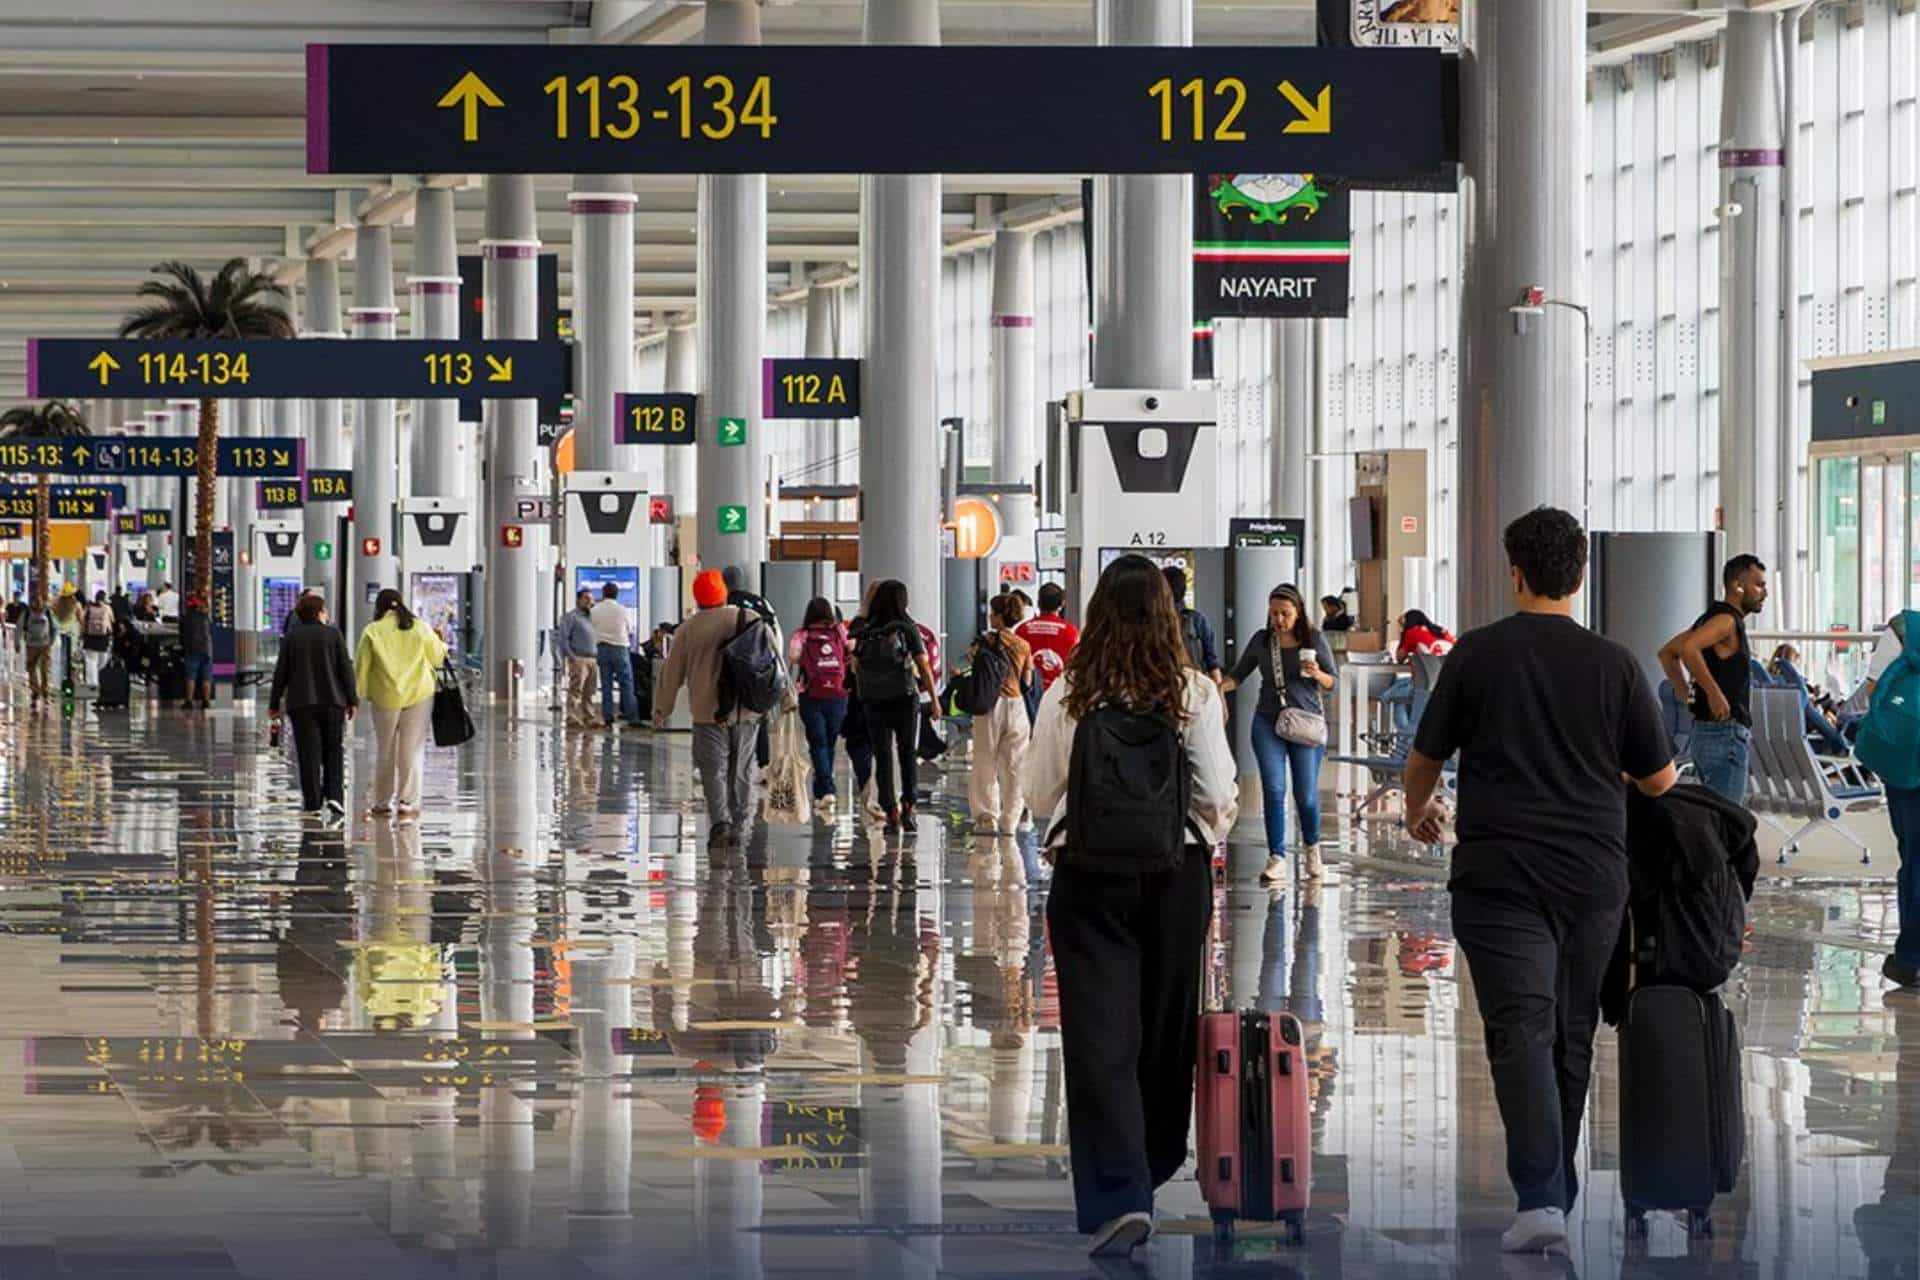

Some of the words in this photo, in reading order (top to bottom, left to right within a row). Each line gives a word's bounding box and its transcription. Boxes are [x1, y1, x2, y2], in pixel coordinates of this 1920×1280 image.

[543, 74, 778, 141] 113-134
[1148, 77, 1247, 142] 112
[1220, 277, 1317, 298] NAYARIT
[139, 352, 251, 387] 114-134
[424, 351, 474, 387] 113
[782, 373, 822, 405] 112
[826, 375, 847, 405] A
[632, 406, 665, 432] 112
[671, 407, 686, 432] B
[232, 448, 267, 467] 113
[264, 487, 286, 503] 113
[287, 487, 297, 503] B
[310, 477, 335, 495] 113
[335, 478, 347, 494] A
[57, 500, 79, 515] 114
[1131, 532, 1143, 545] A
[1148, 532, 1166, 545] 12
